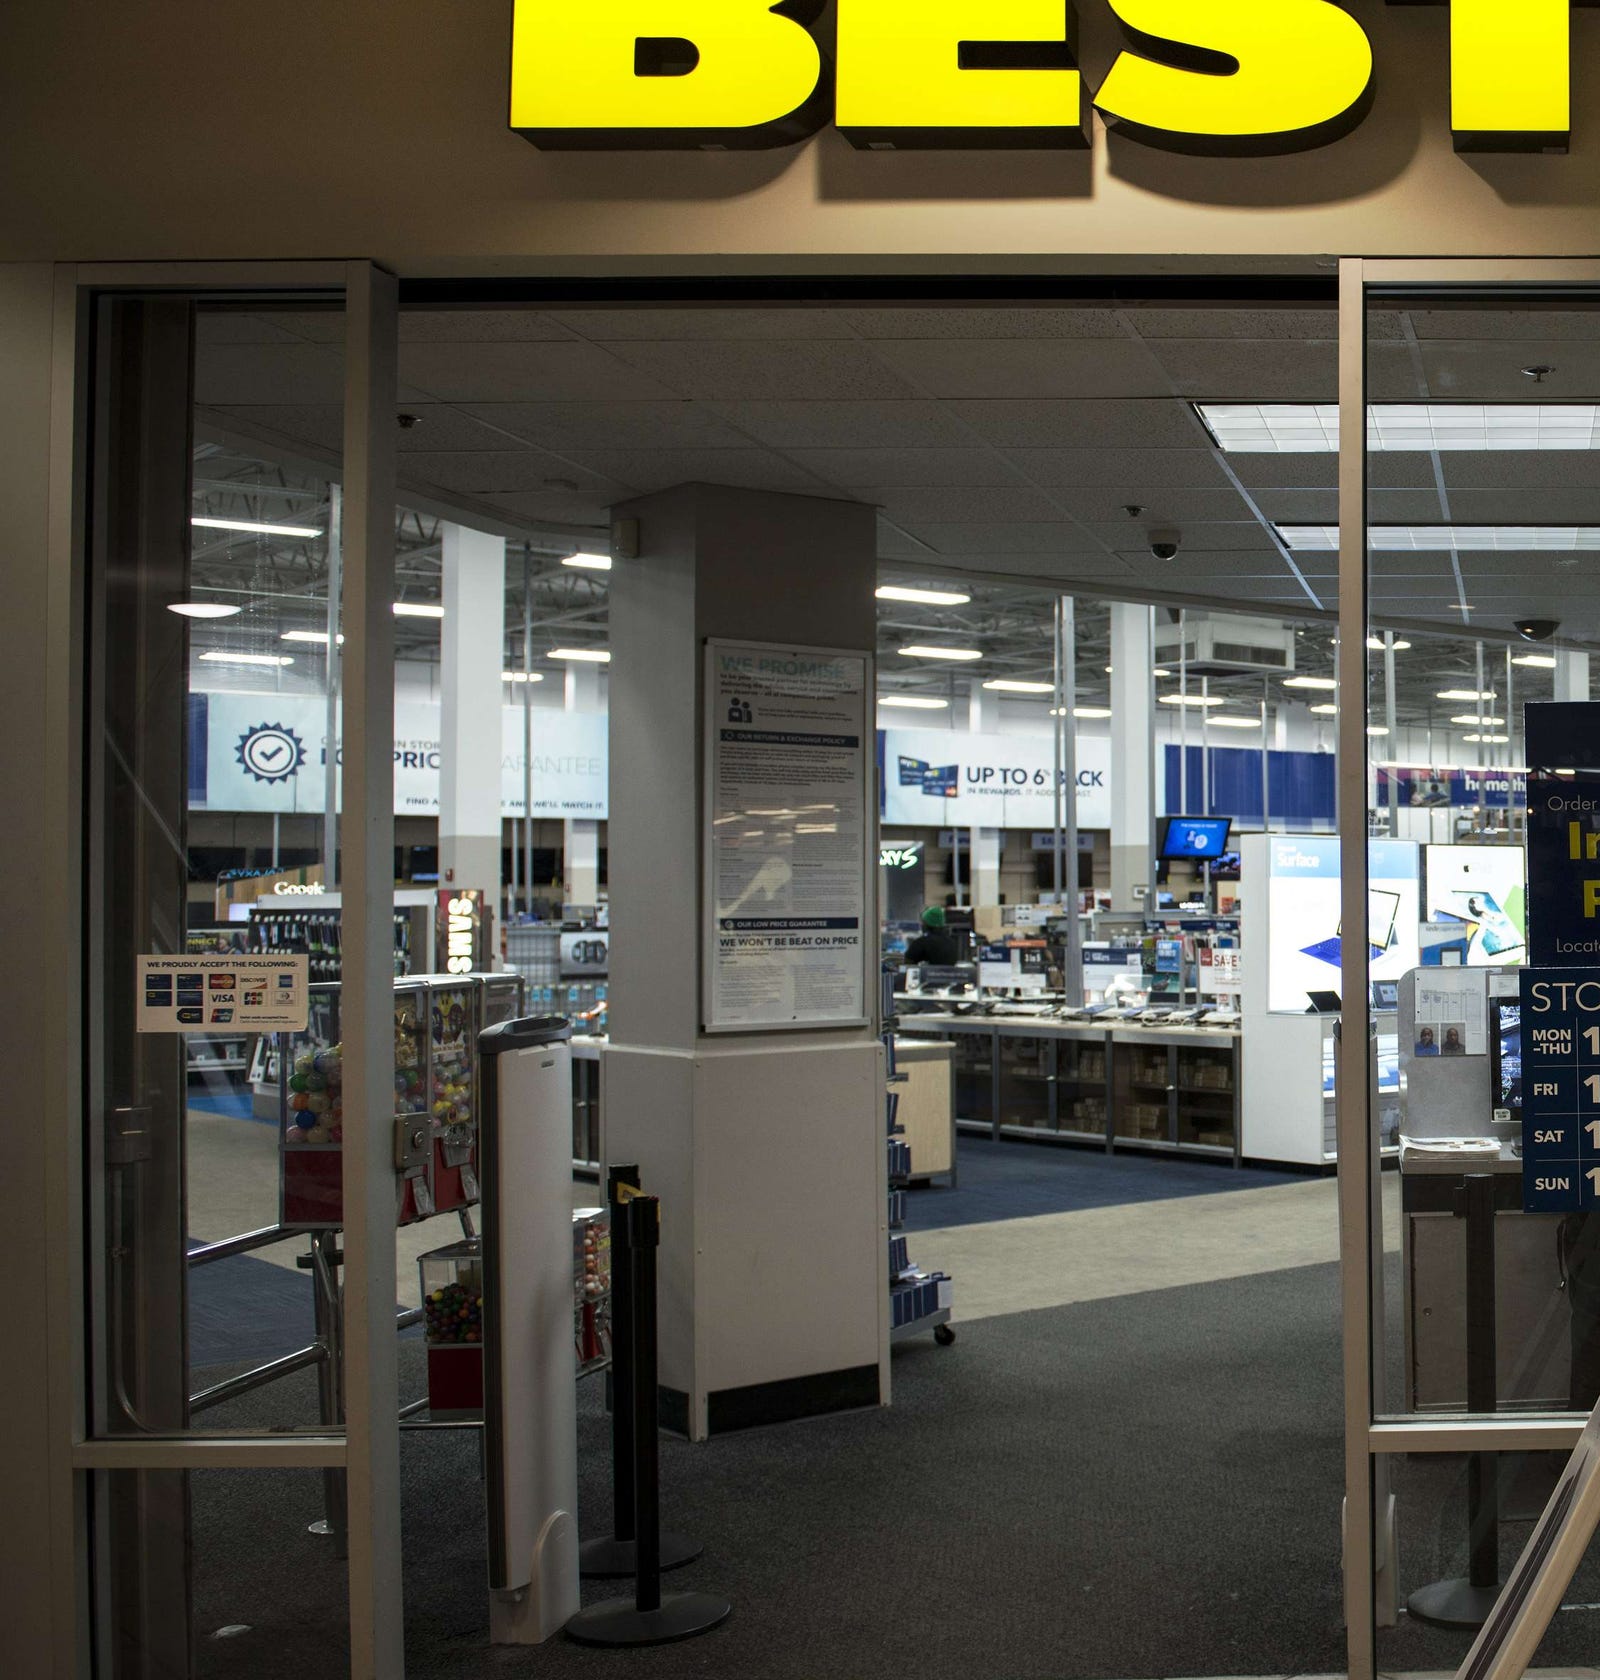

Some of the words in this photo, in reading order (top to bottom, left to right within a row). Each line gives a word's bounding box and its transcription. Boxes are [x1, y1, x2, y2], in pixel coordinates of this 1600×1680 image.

[510, 0, 1572, 140] BEST
[720, 656, 752, 671] WE
[966, 766, 995, 783] UP
[999, 767, 1027, 785] TO
[1055, 770, 1104, 787] BCK
[1547, 795, 1597, 811] Order
[1276, 851, 1320, 869] Surface
[274, 881, 325, 896] Google
[770, 920, 788, 928] PRICE
[788, 920, 828, 928] GUARANTEE
[720, 937, 736, 946] WE
[738, 937, 772, 946] WON'T
[774, 937, 786, 946] BE
[788, 936, 812, 945] BEAT
[814, 936, 829, 945] ON
[832, 936, 858, 945] PRICE
[211, 994, 235, 1003] VISA
[1532, 1029, 1572, 1042] MON
[1533, 1083, 1559, 1096] FRI
[1534, 1130, 1564, 1144] SAT
[1535, 1177, 1570, 1190] SUN
